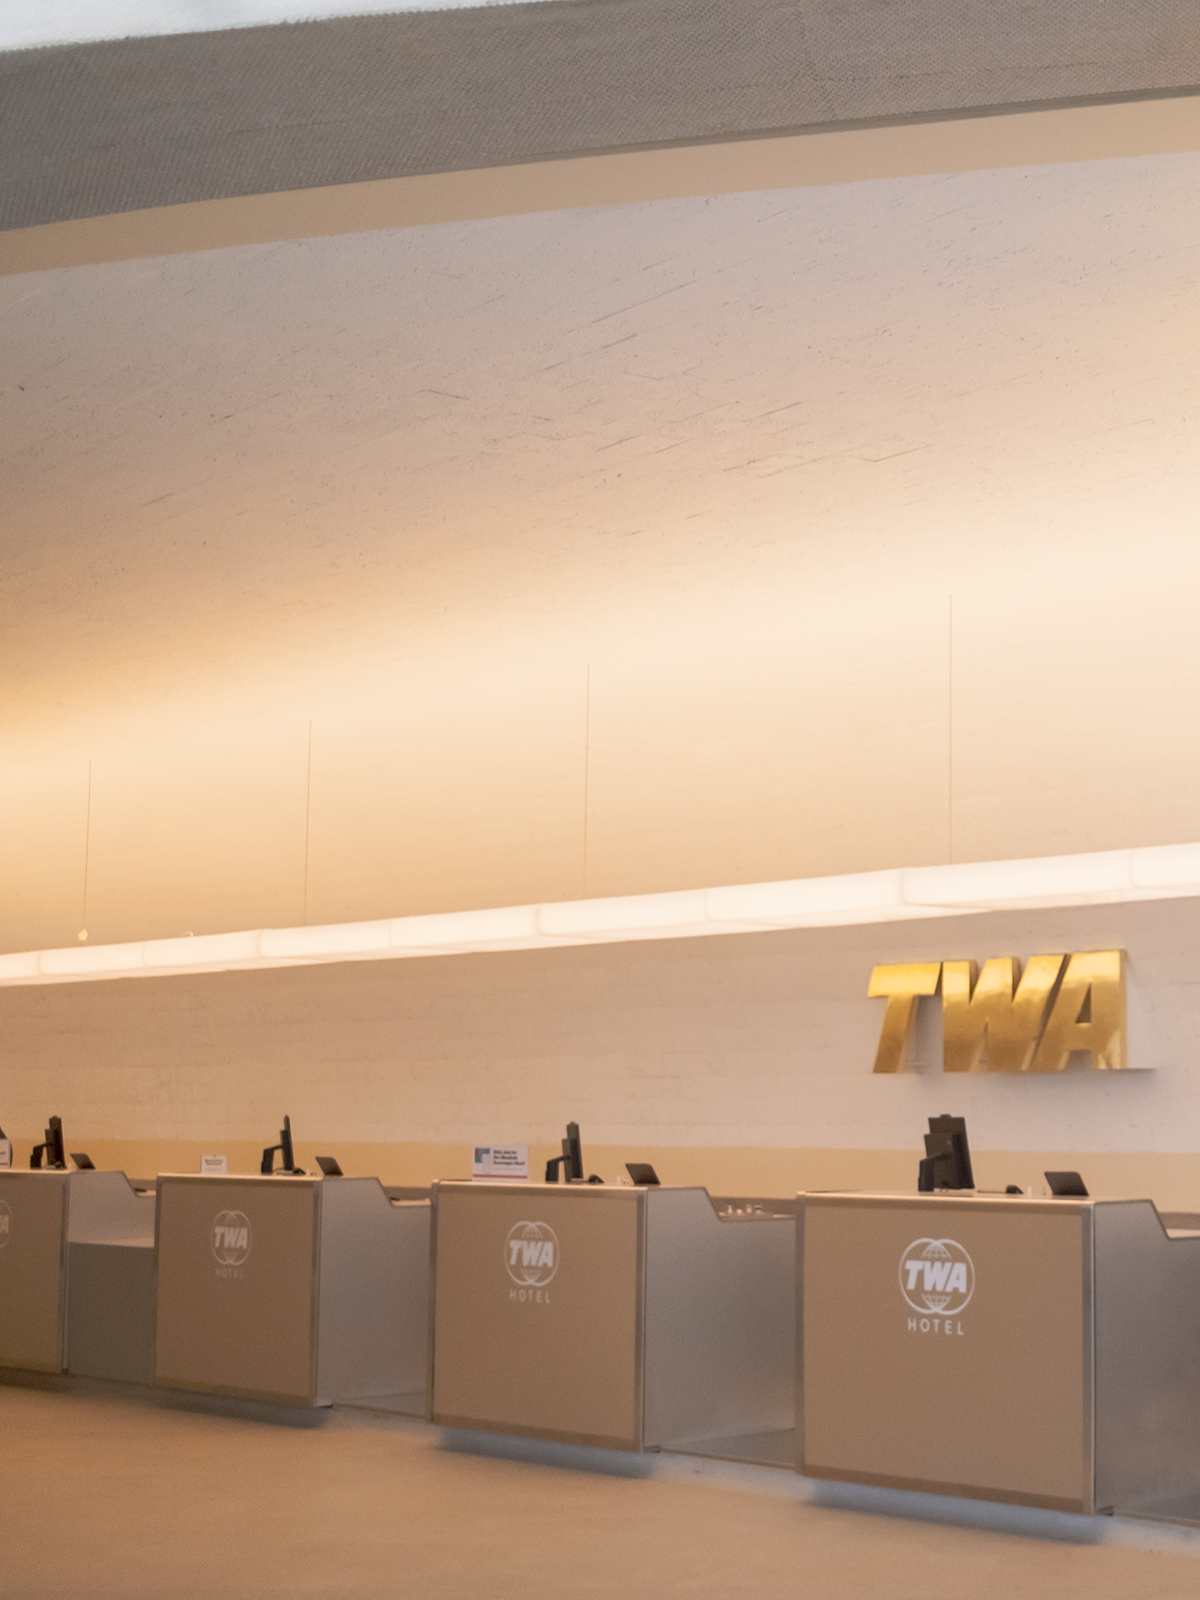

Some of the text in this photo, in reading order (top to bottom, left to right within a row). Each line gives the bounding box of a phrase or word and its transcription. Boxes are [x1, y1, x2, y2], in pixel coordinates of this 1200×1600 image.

[867, 948, 1128, 1074] TWA
[214, 1226, 248, 1249] TWA
[509, 1240, 554, 1268] TWA
[905, 1259, 967, 1293] TWA
[509, 1288, 551, 1304] HOTEL
[907, 1317, 965, 1336] HOTEL
